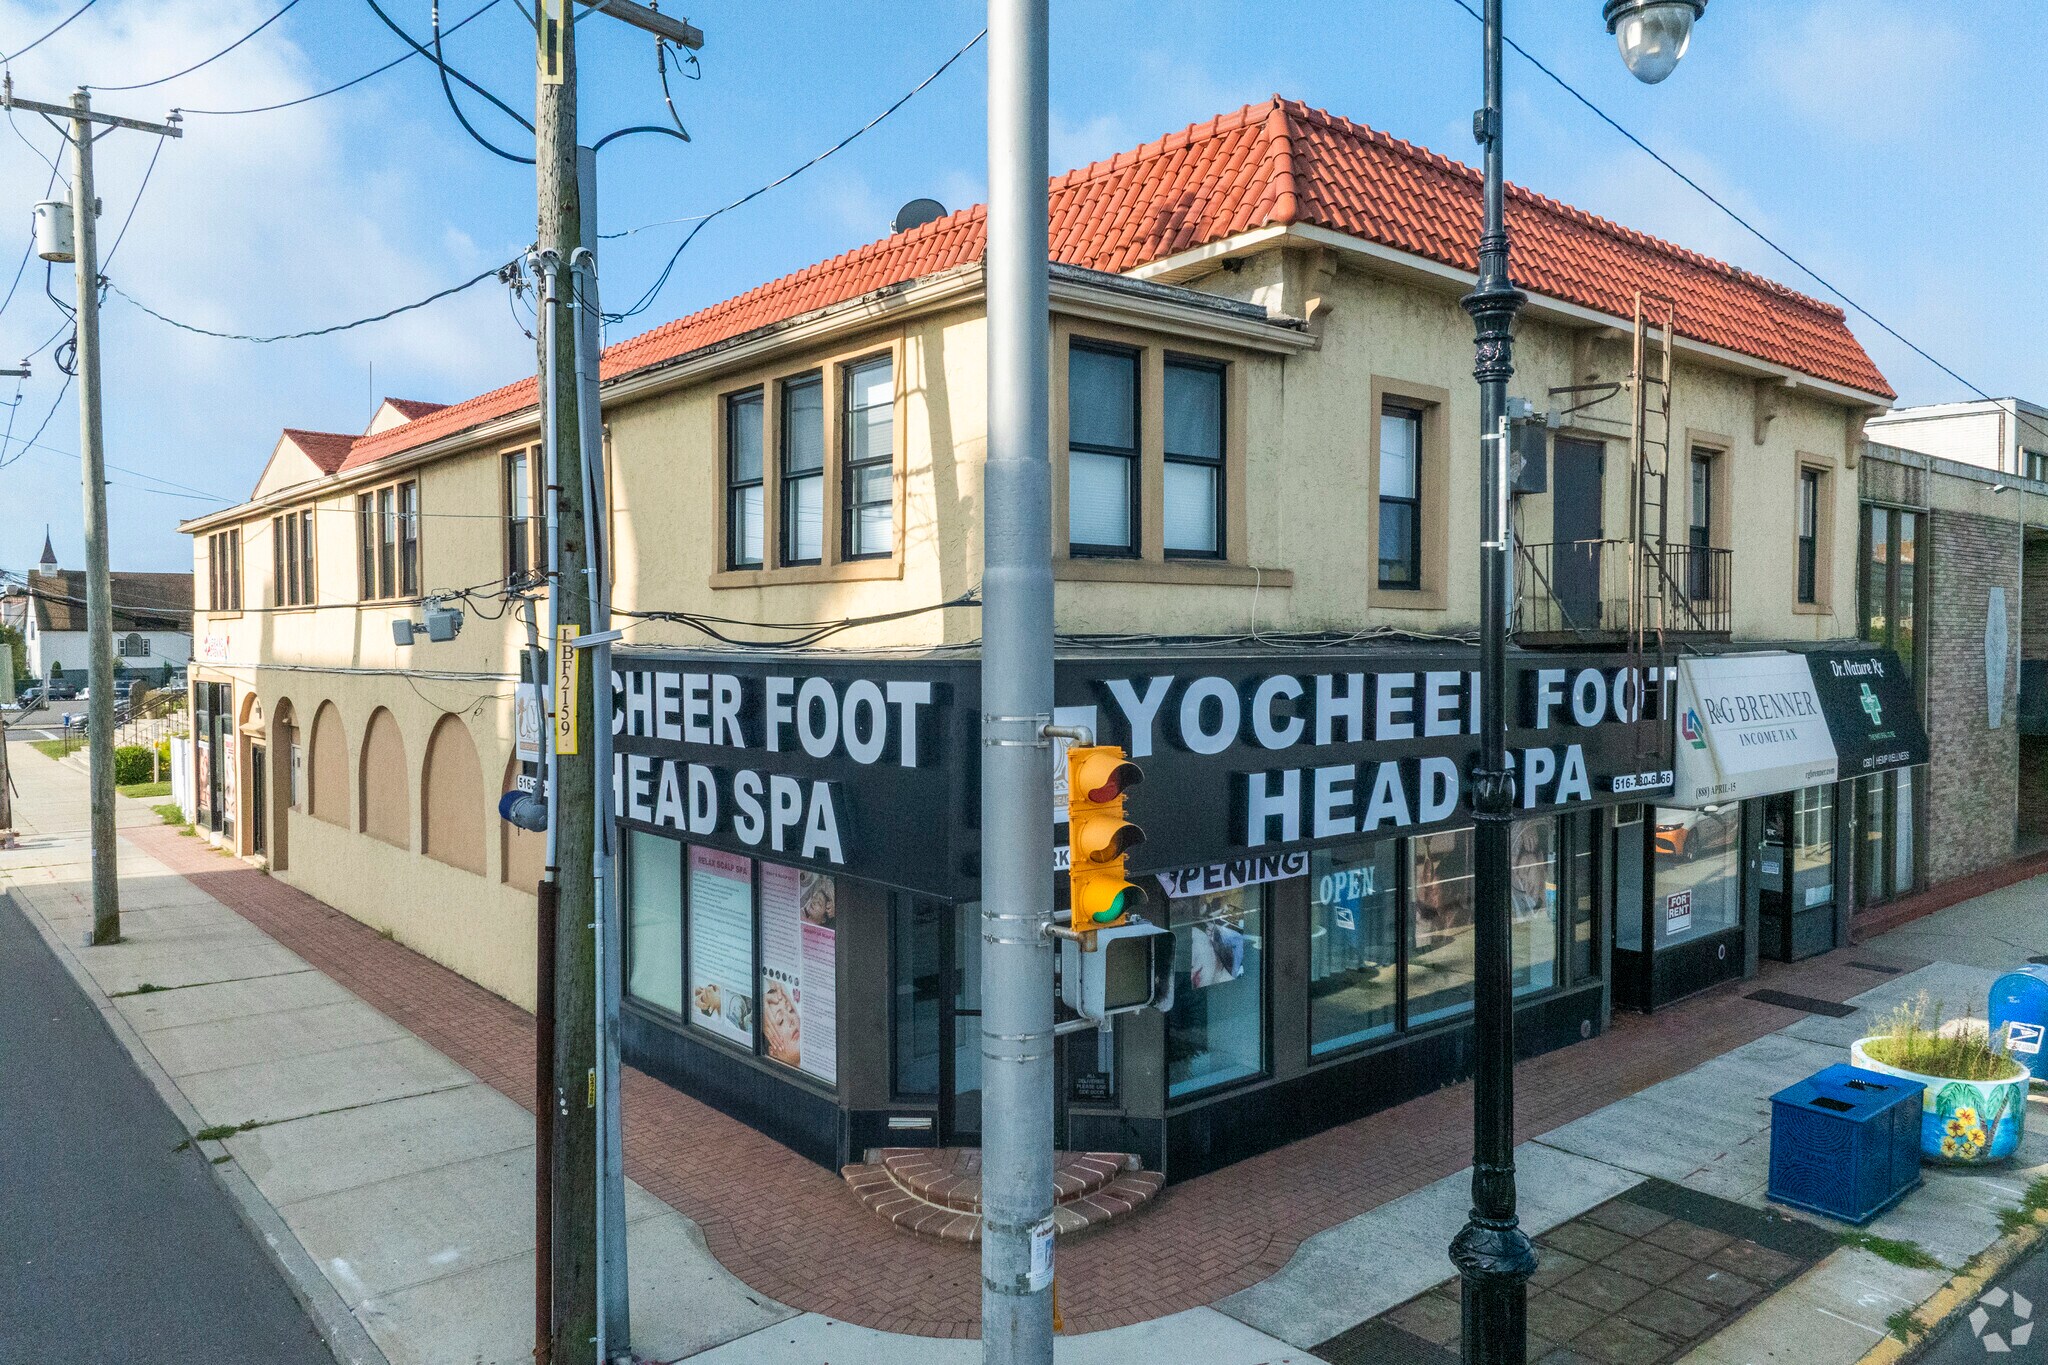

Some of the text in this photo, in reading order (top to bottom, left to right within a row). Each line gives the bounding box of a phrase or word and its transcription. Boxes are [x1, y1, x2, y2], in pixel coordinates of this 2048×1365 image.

[561, 628, 574, 737] LBF2159
[1844, 659, 1873, 676] Nature
[1871, 658, 1884, 678] Rx
[1537, 667, 1678, 731] FOOT
[1703, 691, 1818, 725] R&G BRENNER
[766, 677, 931, 768] FOOT
[1739, 727, 1798, 746] INCOME TAX
[1248, 744, 1592, 848] HEAD PA
[1614, 773, 1671, 790] 516-70-666
[1695, 782, 1737, 800] (888) APRIL-15
[733, 769, 845, 865] SPA
[716, 860, 734, 872] SCALP
[1168, 852, 1306, 897] PENING
[1320, 866, 1375, 906] OPEN
[1671, 894, 1687, 908] FOR
[1668, 904, 1690, 919] RENT
